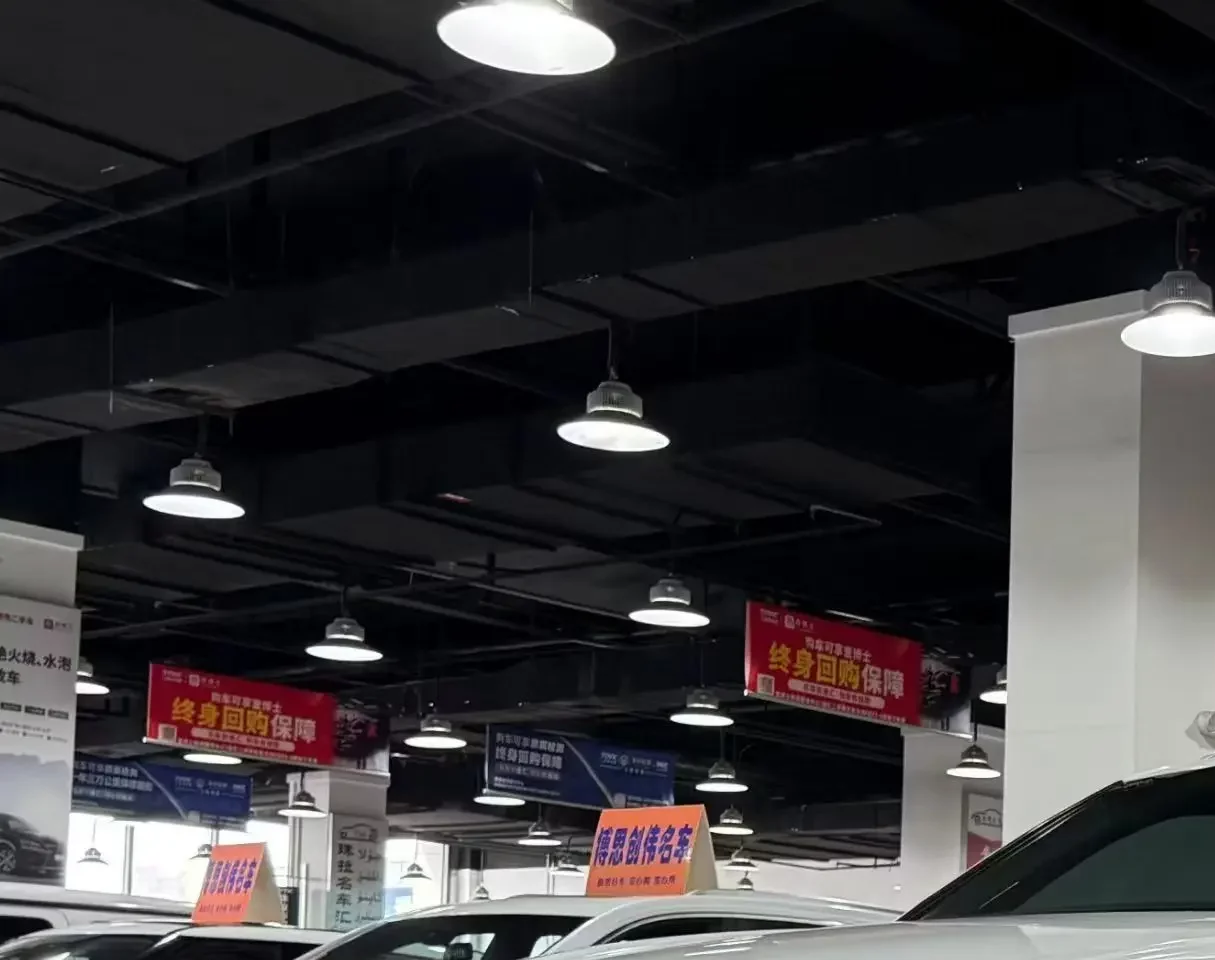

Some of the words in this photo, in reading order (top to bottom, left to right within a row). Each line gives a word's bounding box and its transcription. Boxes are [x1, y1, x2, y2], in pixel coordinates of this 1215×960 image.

[768, 640, 905, 700] 终身回购保障
[171, 696, 317, 744] 终身回购保障
[594, 824, 693, 867] 博思创伟名车
